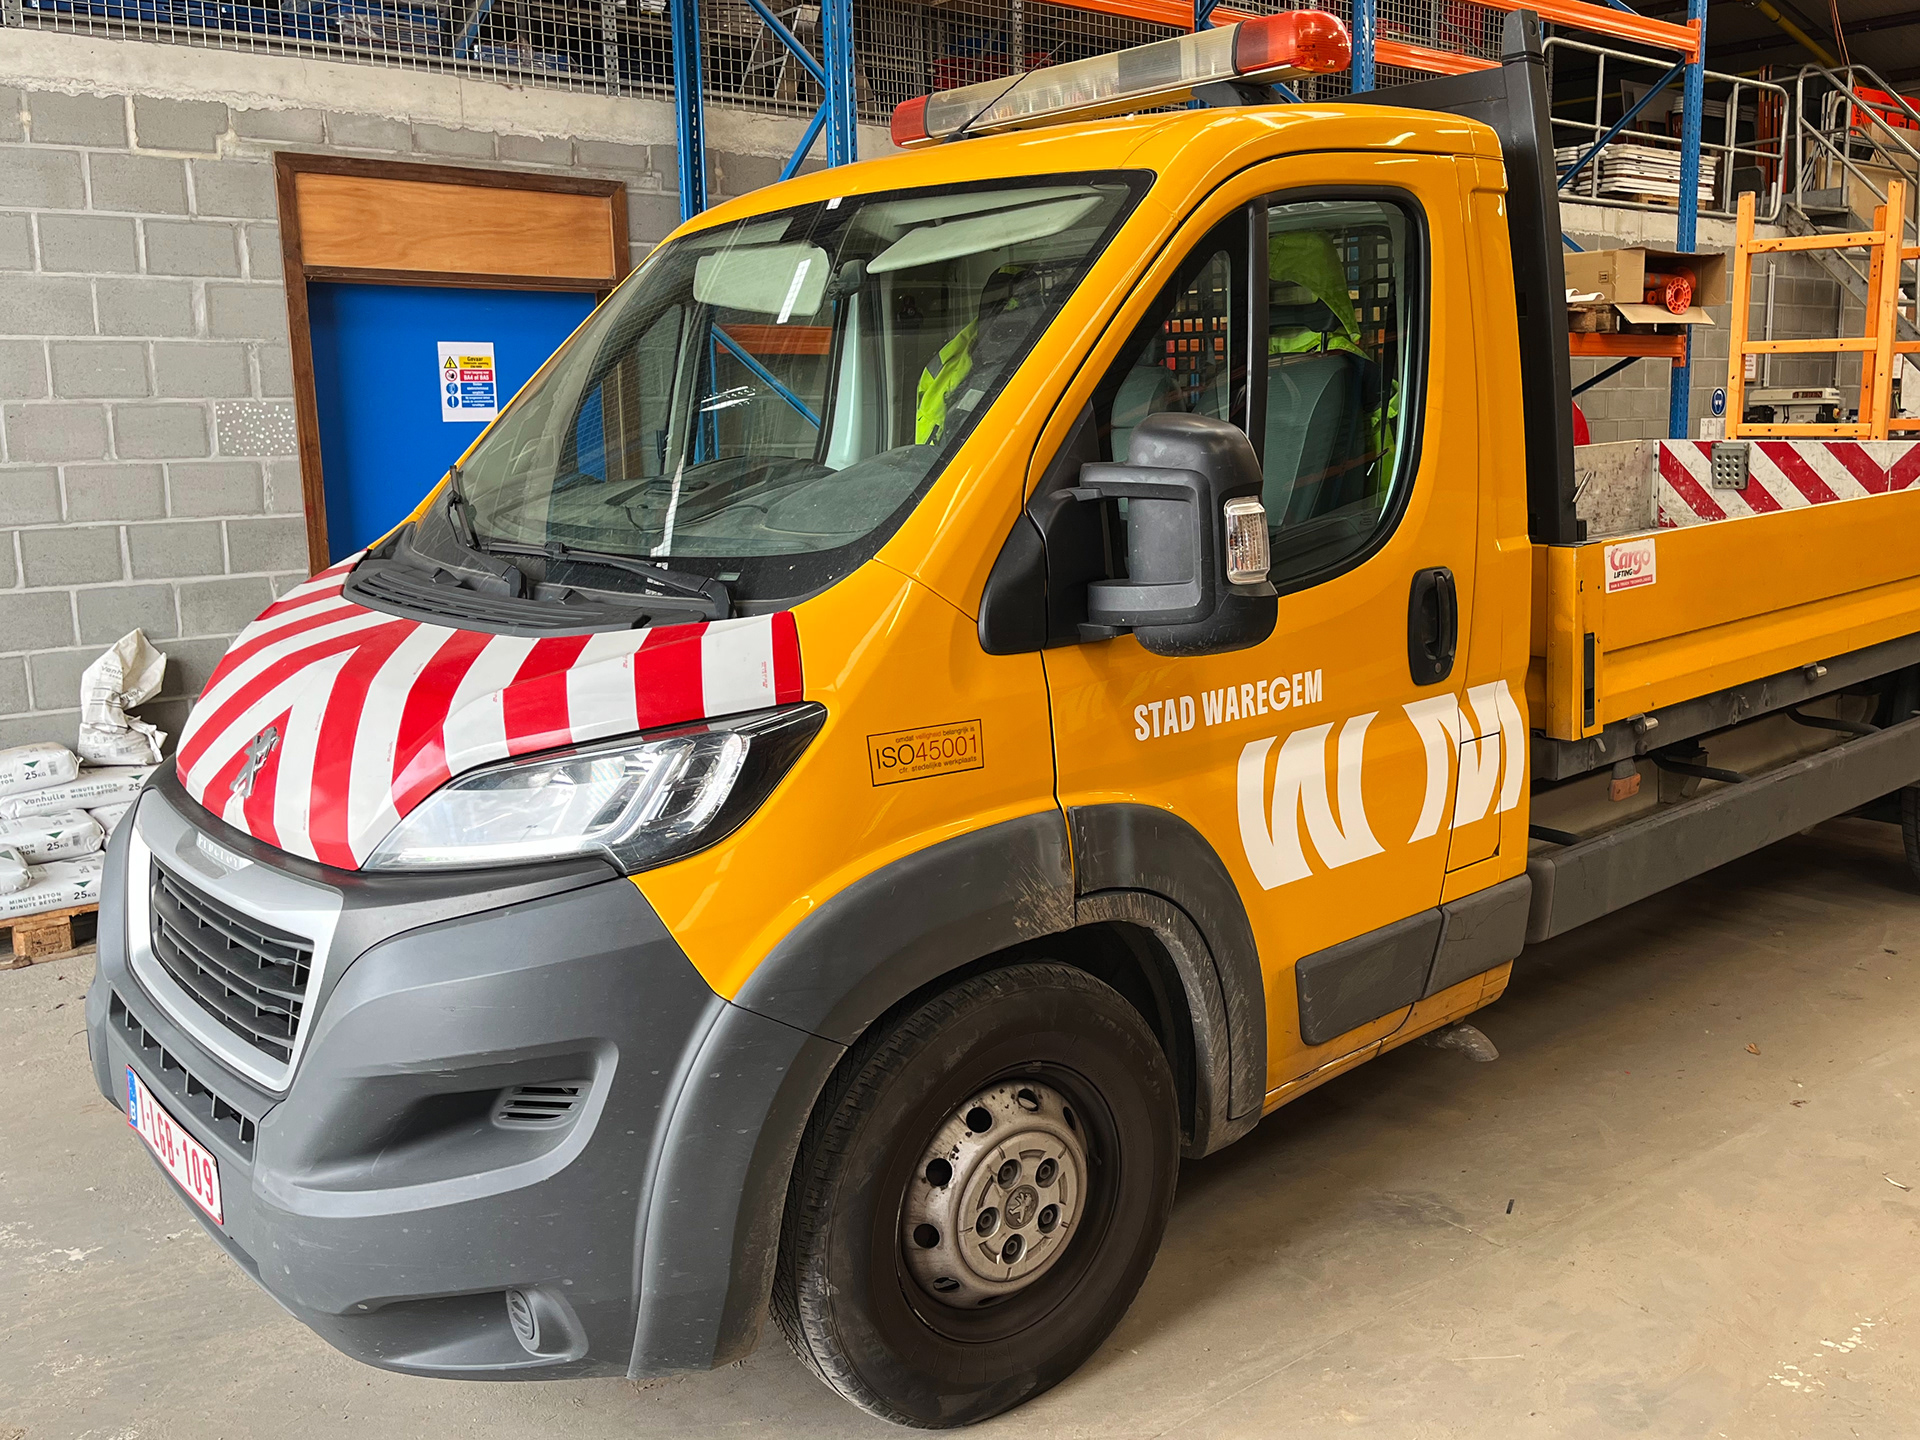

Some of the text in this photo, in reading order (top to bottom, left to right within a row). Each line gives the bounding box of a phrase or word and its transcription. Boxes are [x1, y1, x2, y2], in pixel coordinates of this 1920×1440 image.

[1610, 548, 1650, 575] Cargo
[1614, 568, 1633, 579] LIFTING
[101, 666, 123, 676] Vanh
[1134, 668, 1323, 741] STAD WAREGEM
[896, 735, 914, 743] omdat
[915, 730, 941, 740] veiligheid
[942, 727, 969, 736] belangrijk
[876, 734, 977, 769] ISO45001
[912, 762, 942, 772] stedelijke
[944, 755, 977, 766] werkplaats
[129, 783, 142, 791] 25
[24, 792, 66, 805] Vanhulle
[9, 896, 35, 905] MINUTE
[130, 1101, 137, 1121] B
[139, 1087, 214, 1206] 1-LGB-109
